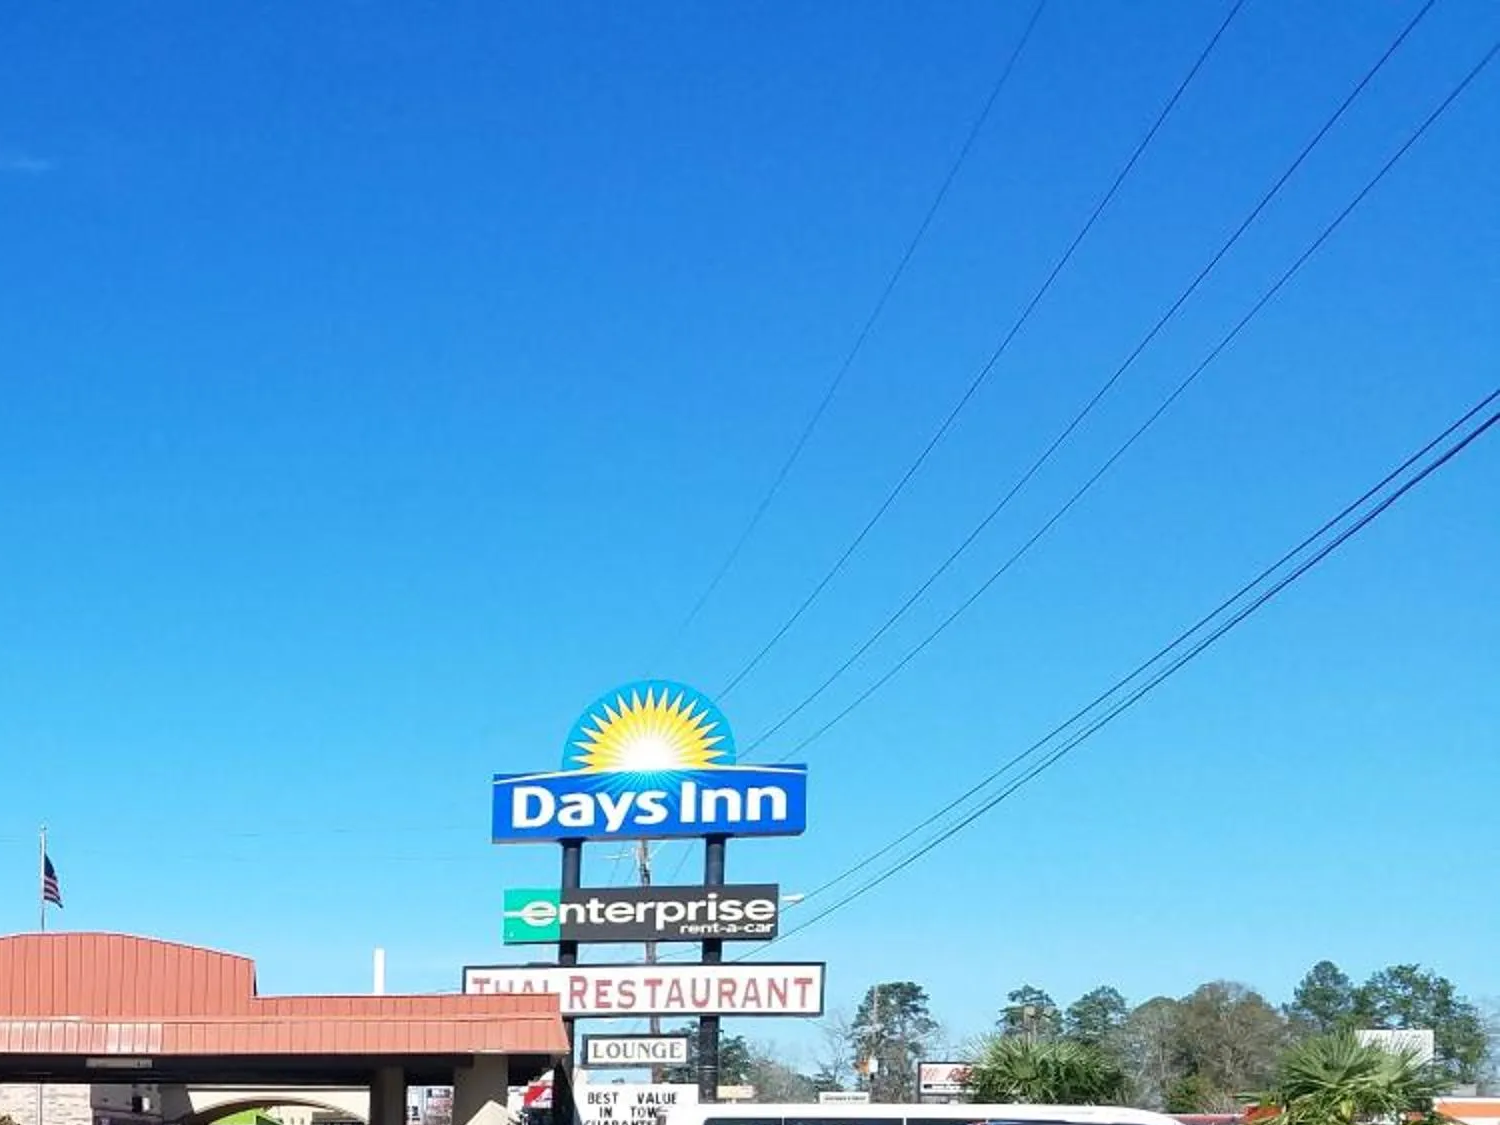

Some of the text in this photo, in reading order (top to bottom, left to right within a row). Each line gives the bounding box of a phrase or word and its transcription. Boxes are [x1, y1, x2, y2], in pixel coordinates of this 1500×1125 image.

[511, 780, 788, 832] Days Inn
[522, 893, 776, 930] enterprise
[679, 921, 774, 935] rent-a-car
[569, 975, 813, 1009] RESTAURANT
[592, 1041, 683, 1059] LOUNGE
[587, 1091, 678, 1105] BEST VALUE
[600, 1106, 660, 1119] IN TOW
